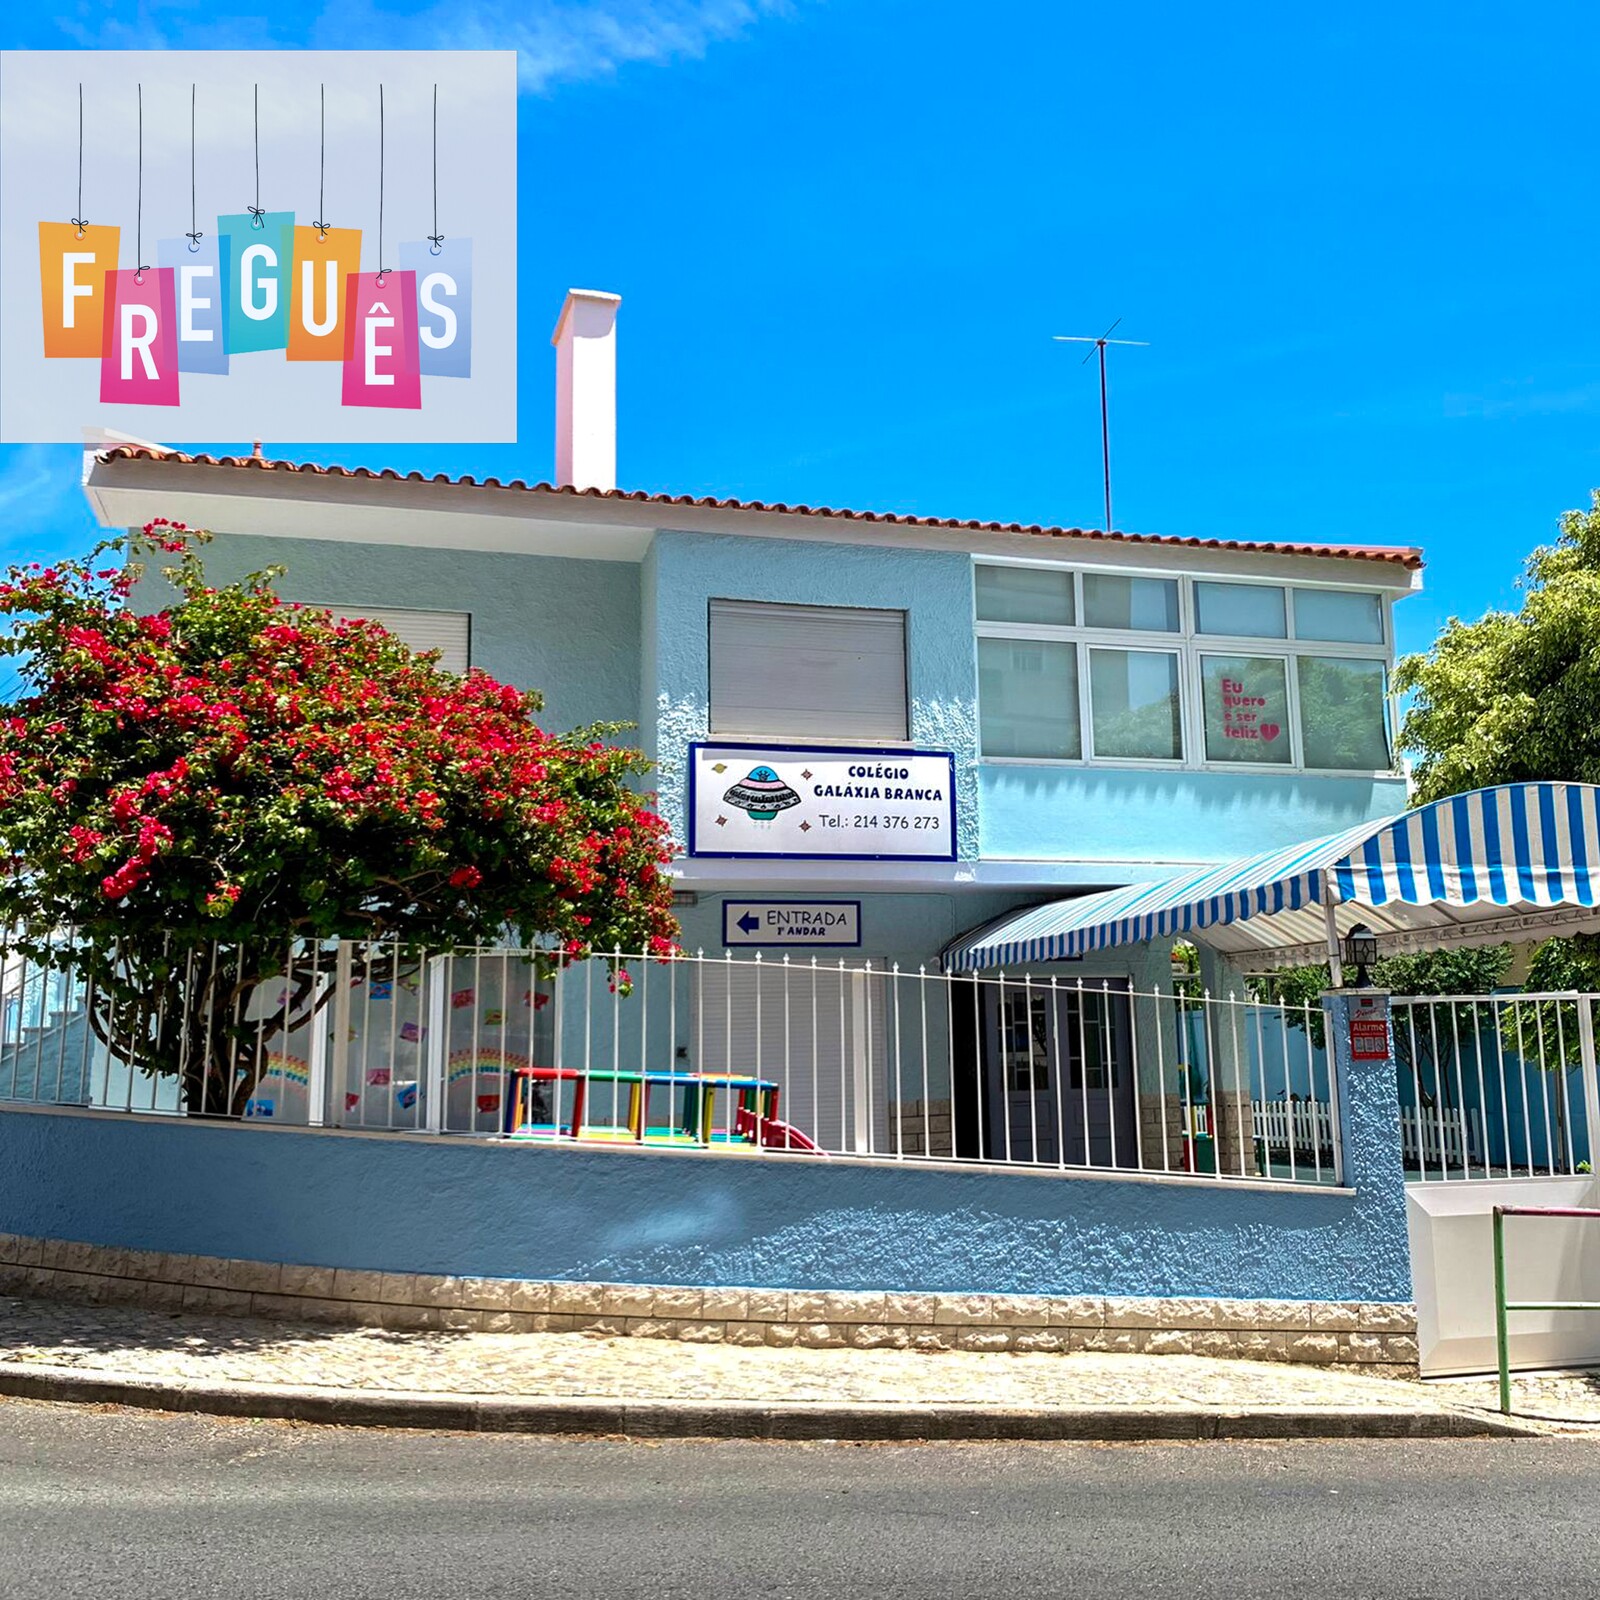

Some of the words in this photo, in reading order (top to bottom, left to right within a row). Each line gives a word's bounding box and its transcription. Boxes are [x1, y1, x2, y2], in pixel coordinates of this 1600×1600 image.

[1222, 679, 1243, 693] Eu
[1236, 713, 1257, 722] ser
[1225, 725, 1259, 739] feliz
[848, 763, 909, 780] COLÉGIO
[813, 782, 880, 798] GALÁXIA
[884, 787, 943, 801] BRANCA
[818, 814, 848, 828] Tel.:
[853, 815, 878, 828] 214
[883, 816, 909, 829] 376
[914, 816, 940, 829] 273
[767, 910, 847, 925] ENTRADA
[787, 926, 826, 936] ANDAR
[1353, 1023, 1385, 1032] Alarme
